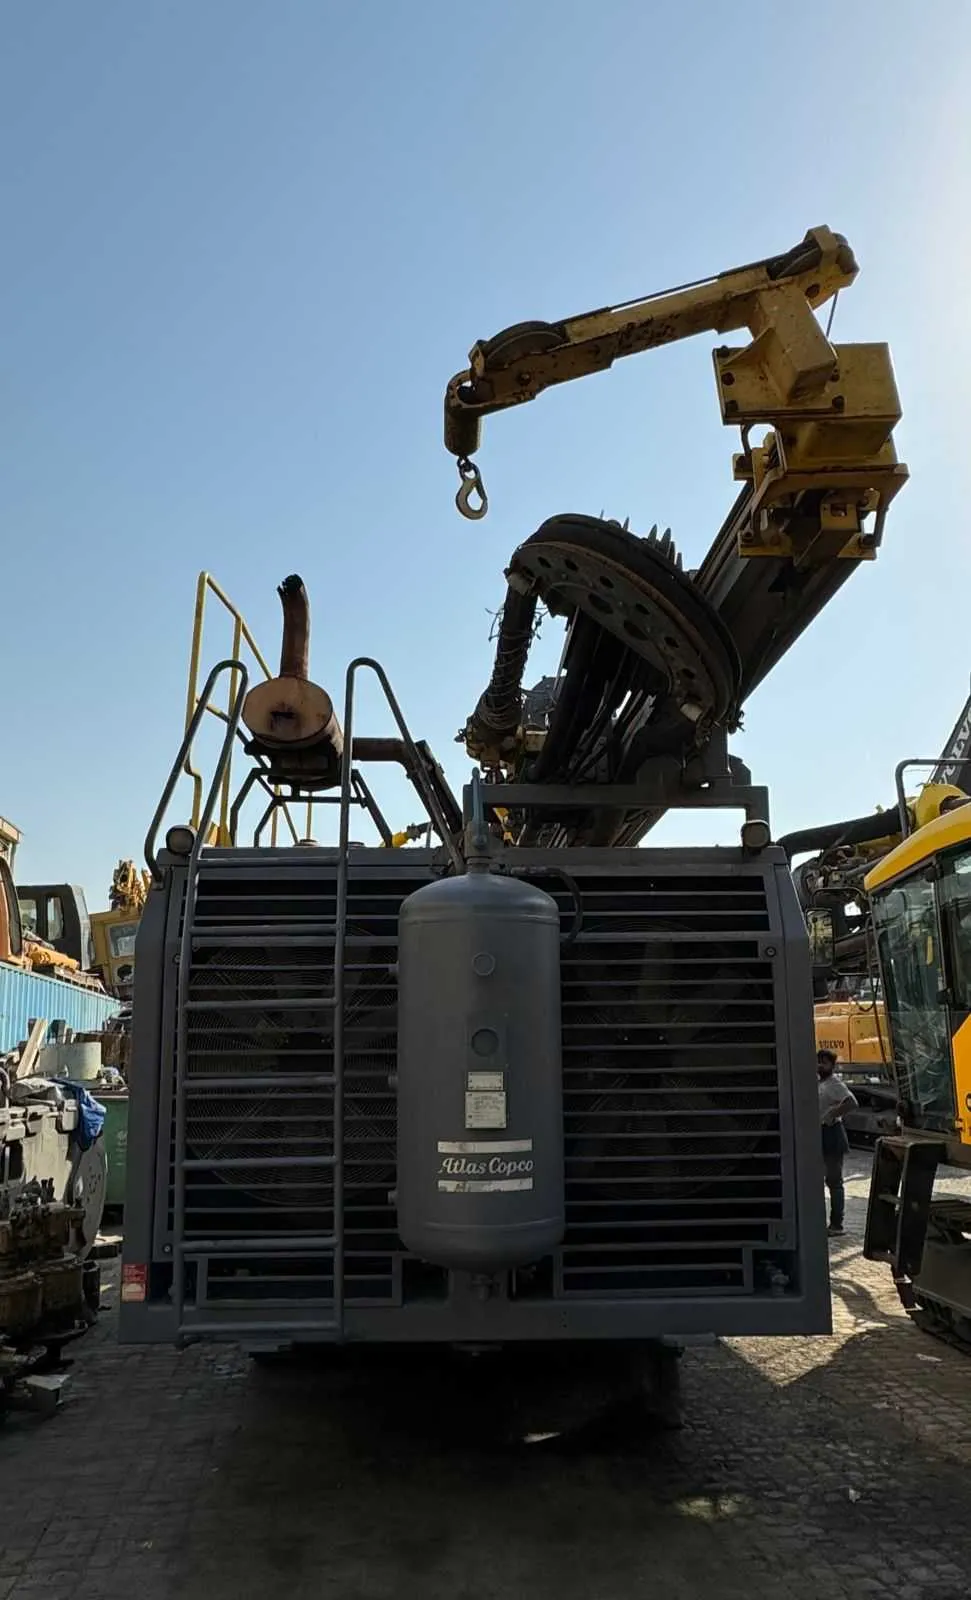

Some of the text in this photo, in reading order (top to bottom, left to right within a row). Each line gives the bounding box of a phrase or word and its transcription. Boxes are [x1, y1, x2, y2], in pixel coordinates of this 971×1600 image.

[819, 1040, 844, 1049] VOLVO
[438, 1156, 534, 1177] Atlas Copco
